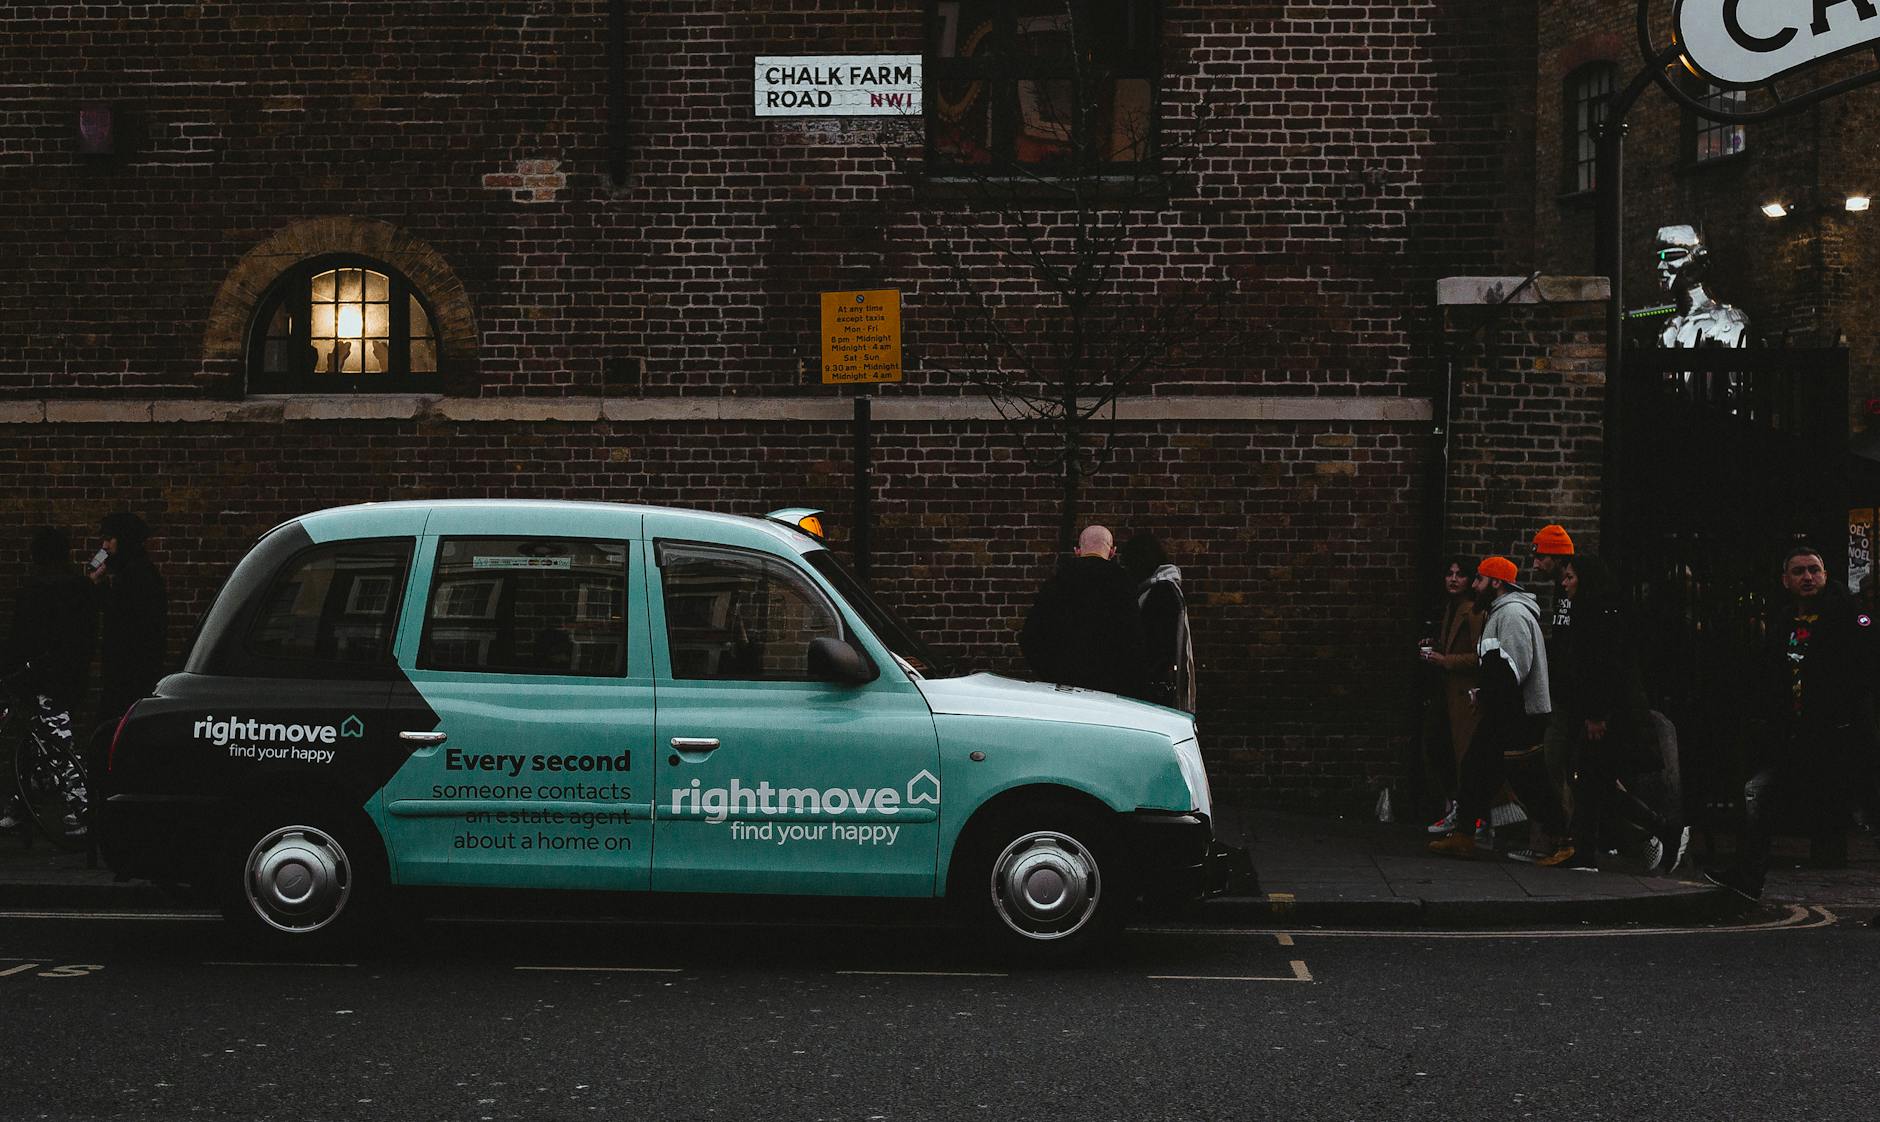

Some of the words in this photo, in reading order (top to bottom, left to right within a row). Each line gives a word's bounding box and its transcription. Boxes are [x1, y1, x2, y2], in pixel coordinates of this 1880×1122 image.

[765, 66, 843, 85] CHALK
[850, 66, 912, 85] FARM
[767, 90, 832, 108] ROAD
[849, 306, 863, 314] any
[866, 304, 884, 312] time
[836, 315, 863, 323] except
[865, 314, 885, 322] taxis
[844, 325, 861, 333] Mon
[867, 324, 878, 332] Fri
[831, 344, 867, 352] Midnight
[856, 335, 892, 343] Midnight
[843, 354, 857, 362] Sat
[863, 353, 880, 361] Sun
[863, 363, 899, 371] Midnight
[831, 373, 867, 381] Midnight
[193, 715, 338, 746] rightmove
[229, 743, 256, 758] find
[257, 746, 290, 762] your
[291, 746, 336, 764] happy
[446, 749, 526, 777] Every
[531, 750, 631, 772] second
[432, 784, 533, 799] someone
[537, 782, 632, 800] contacts
[671, 778, 901, 825] rightmove
[466, 810, 491, 824] an
[496, 808, 565, 824] estate
[569, 808, 632, 830] agent
[454, 831, 516, 850] about
[520, 836, 533, 850] a
[538, 831, 599, 851] home
[604, 836, 632, 851] on
[731, 820, 773, 841] find
[777, 824, 828, 846] your
[832, 820, 900, 846] happy
